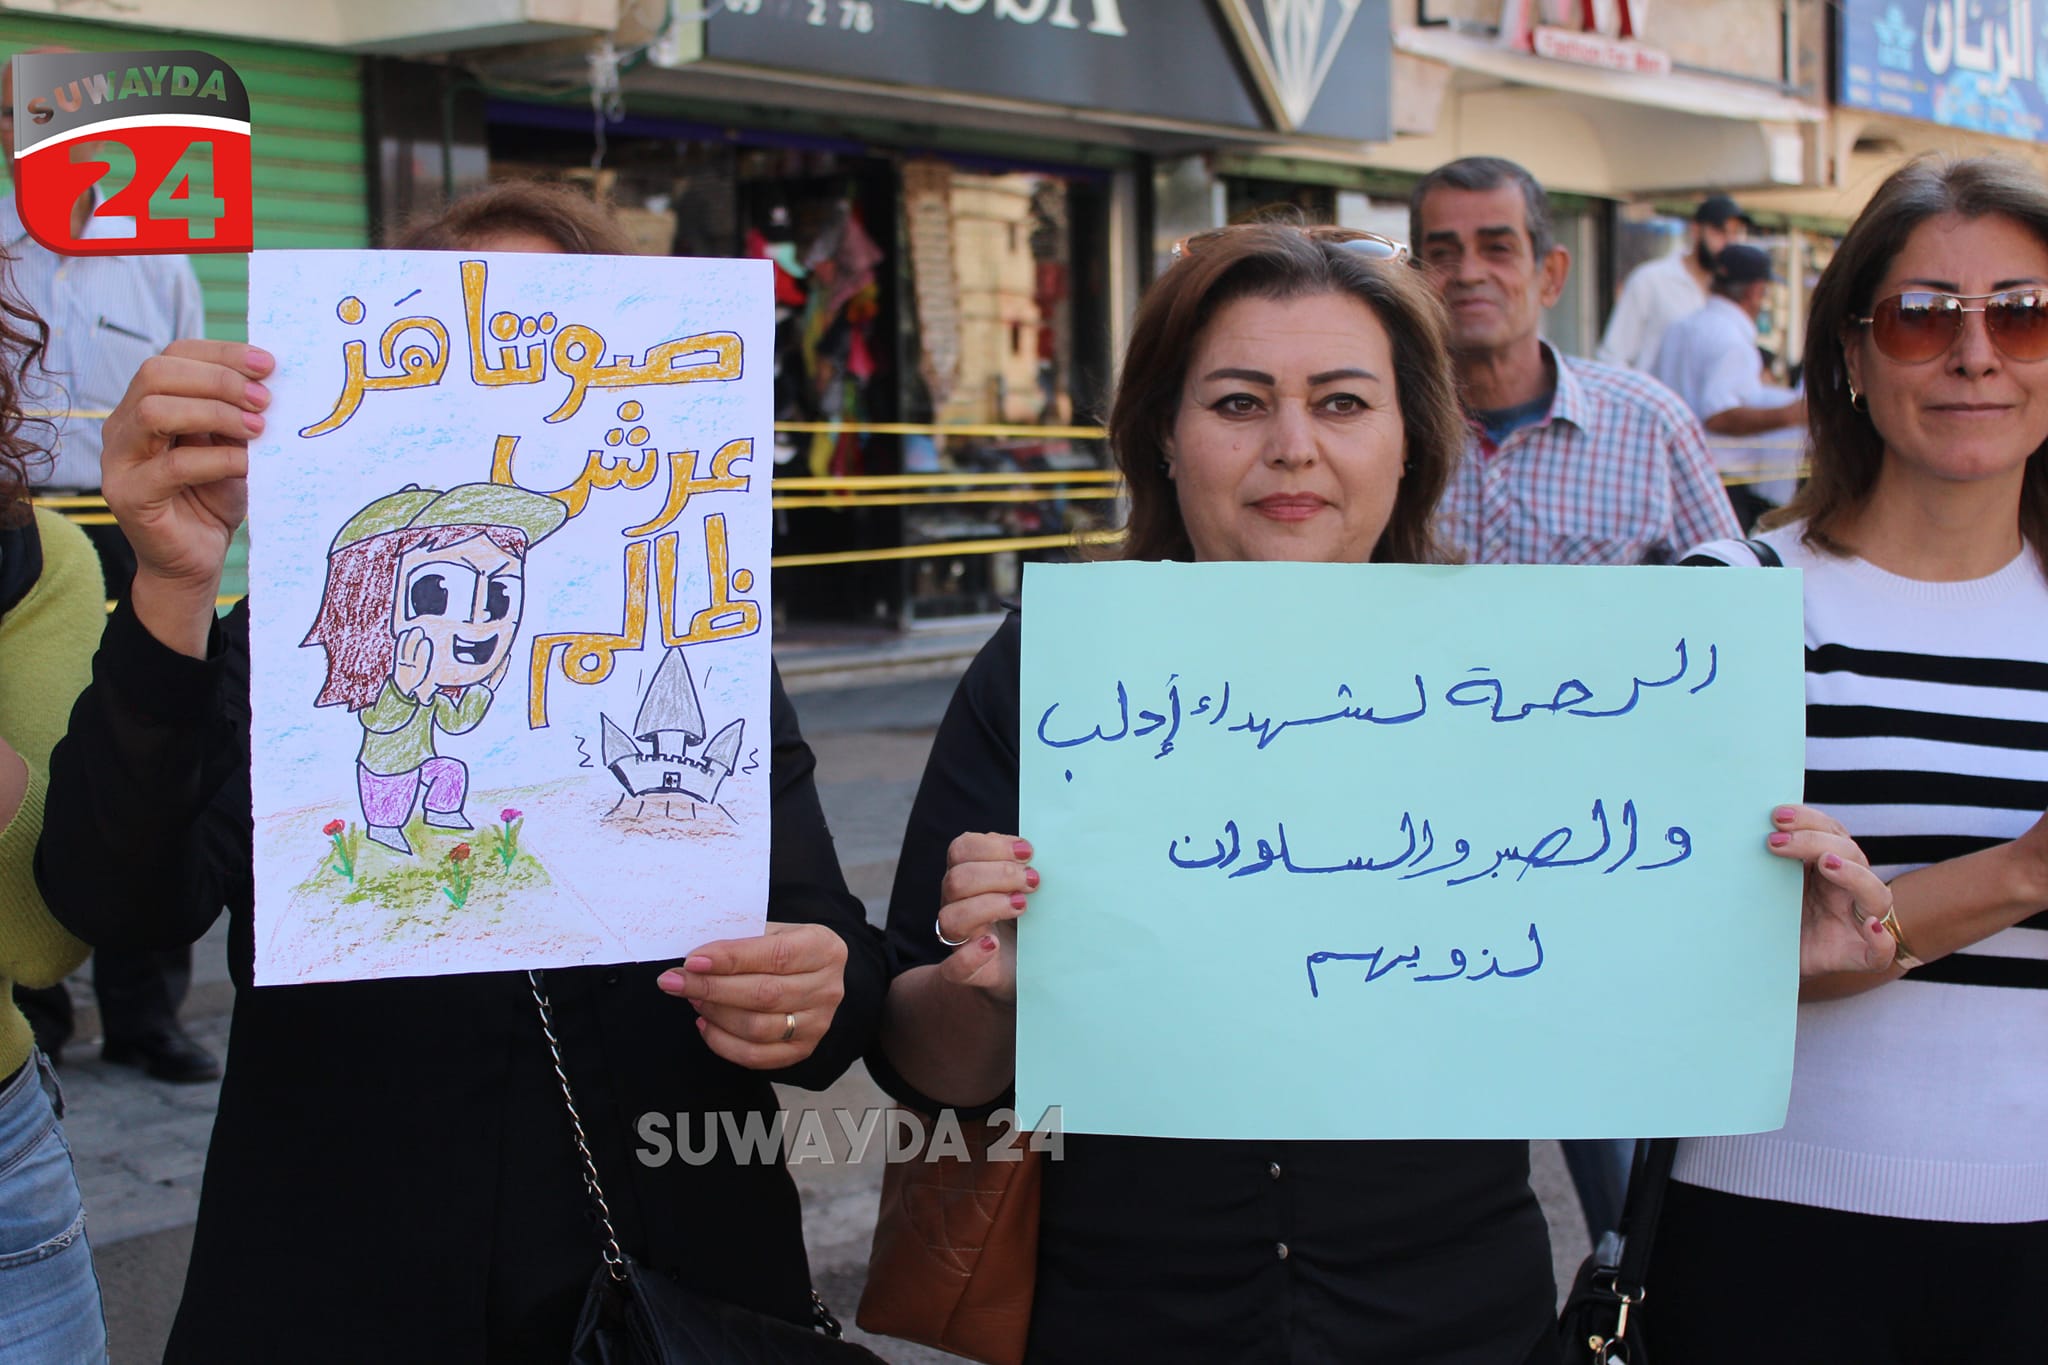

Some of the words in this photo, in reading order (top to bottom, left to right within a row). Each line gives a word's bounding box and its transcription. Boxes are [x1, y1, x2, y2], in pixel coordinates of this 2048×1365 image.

[459, 259, 744, 424] صوتنا
[490, 400, 755, 538] عرش
[528, 512, 762, 731] ظالم
[1445, 637, 1717, 724] الرحمة
